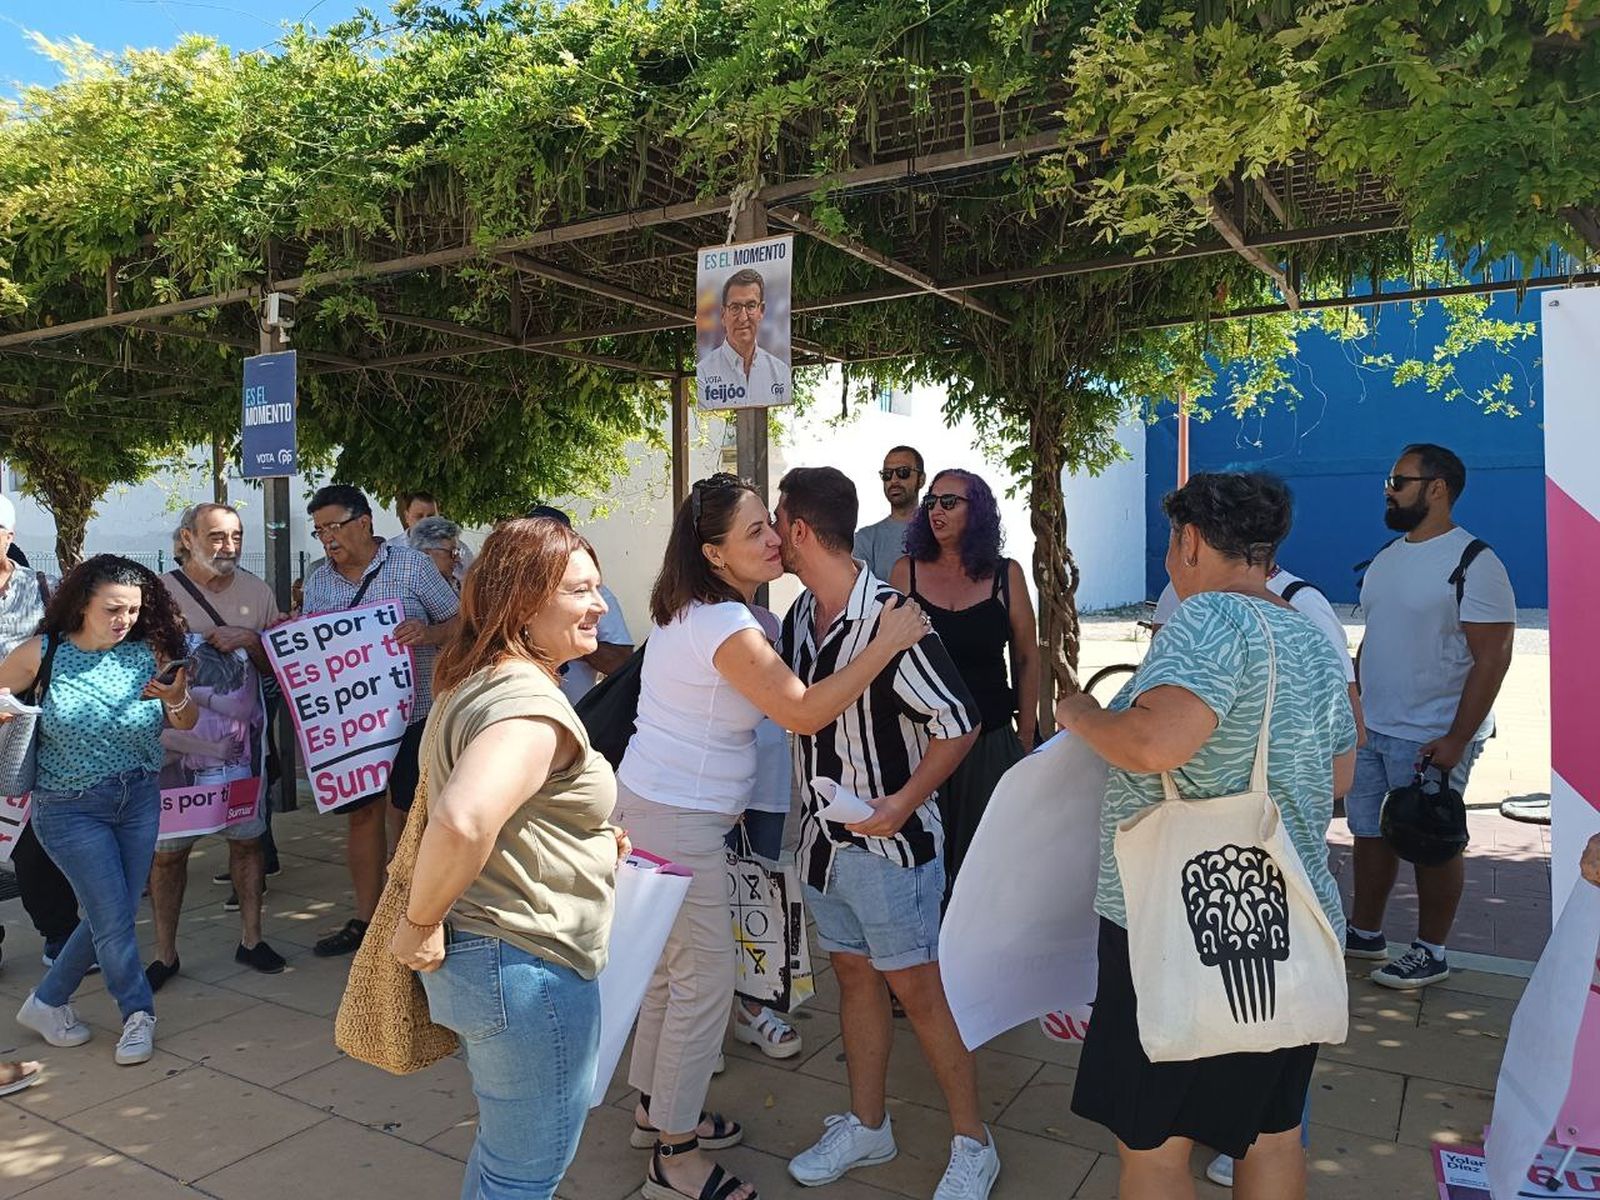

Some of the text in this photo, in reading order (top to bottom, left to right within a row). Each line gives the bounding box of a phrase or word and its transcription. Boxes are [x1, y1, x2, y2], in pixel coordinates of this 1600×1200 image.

[705, 243, 786, 270] ES EL MOMENTO
[705, 376, 722, 384] VOTA
[245, 386, 267, 406] ES EL
[705, 384, 746, 403] feijóo
[245, 403, 292, 426] MOMENTO
[256, 453, 275, 464] VOTA
[269, 605, 398, 658] Es por ti
[282, 662, 321, 689] Es
[325, 642, 373, 682] por
[295, 661, 413, 721] Es por ti
[305, 725, 337, 753] Es
[341, 707, 389, 747] por
[160, 783, 230, 814] s por ti
[227, 806, 253, 819] Sumar
